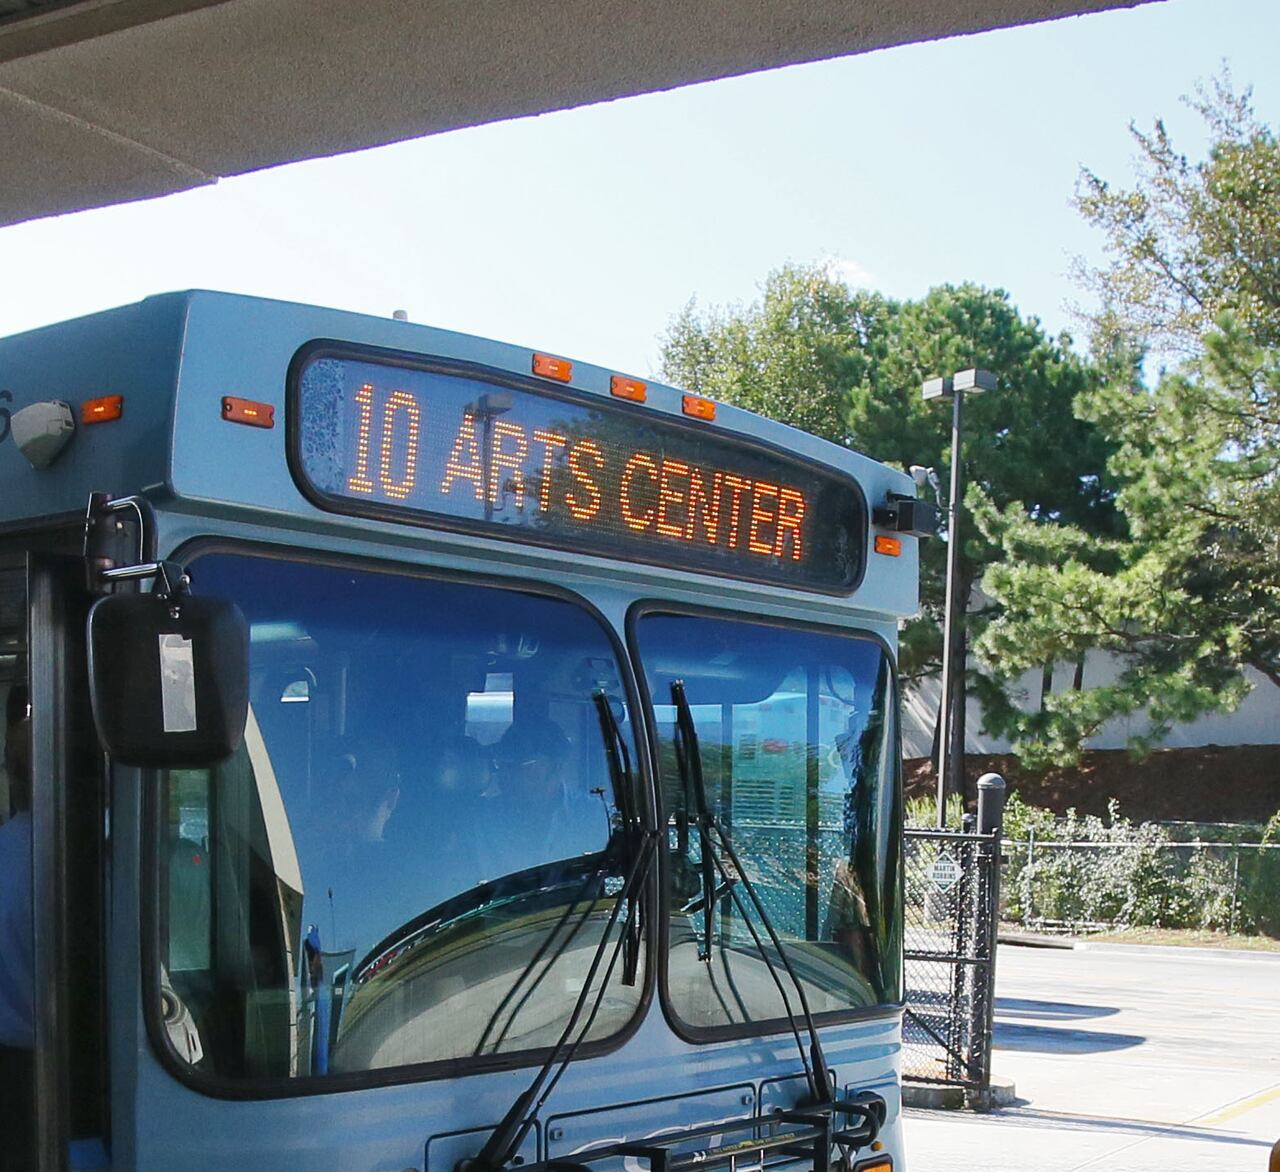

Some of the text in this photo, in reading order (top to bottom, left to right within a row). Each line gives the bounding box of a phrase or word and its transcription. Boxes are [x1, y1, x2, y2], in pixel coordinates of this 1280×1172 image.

[348, 382, 806, 561] 10 ARTS CENTER
